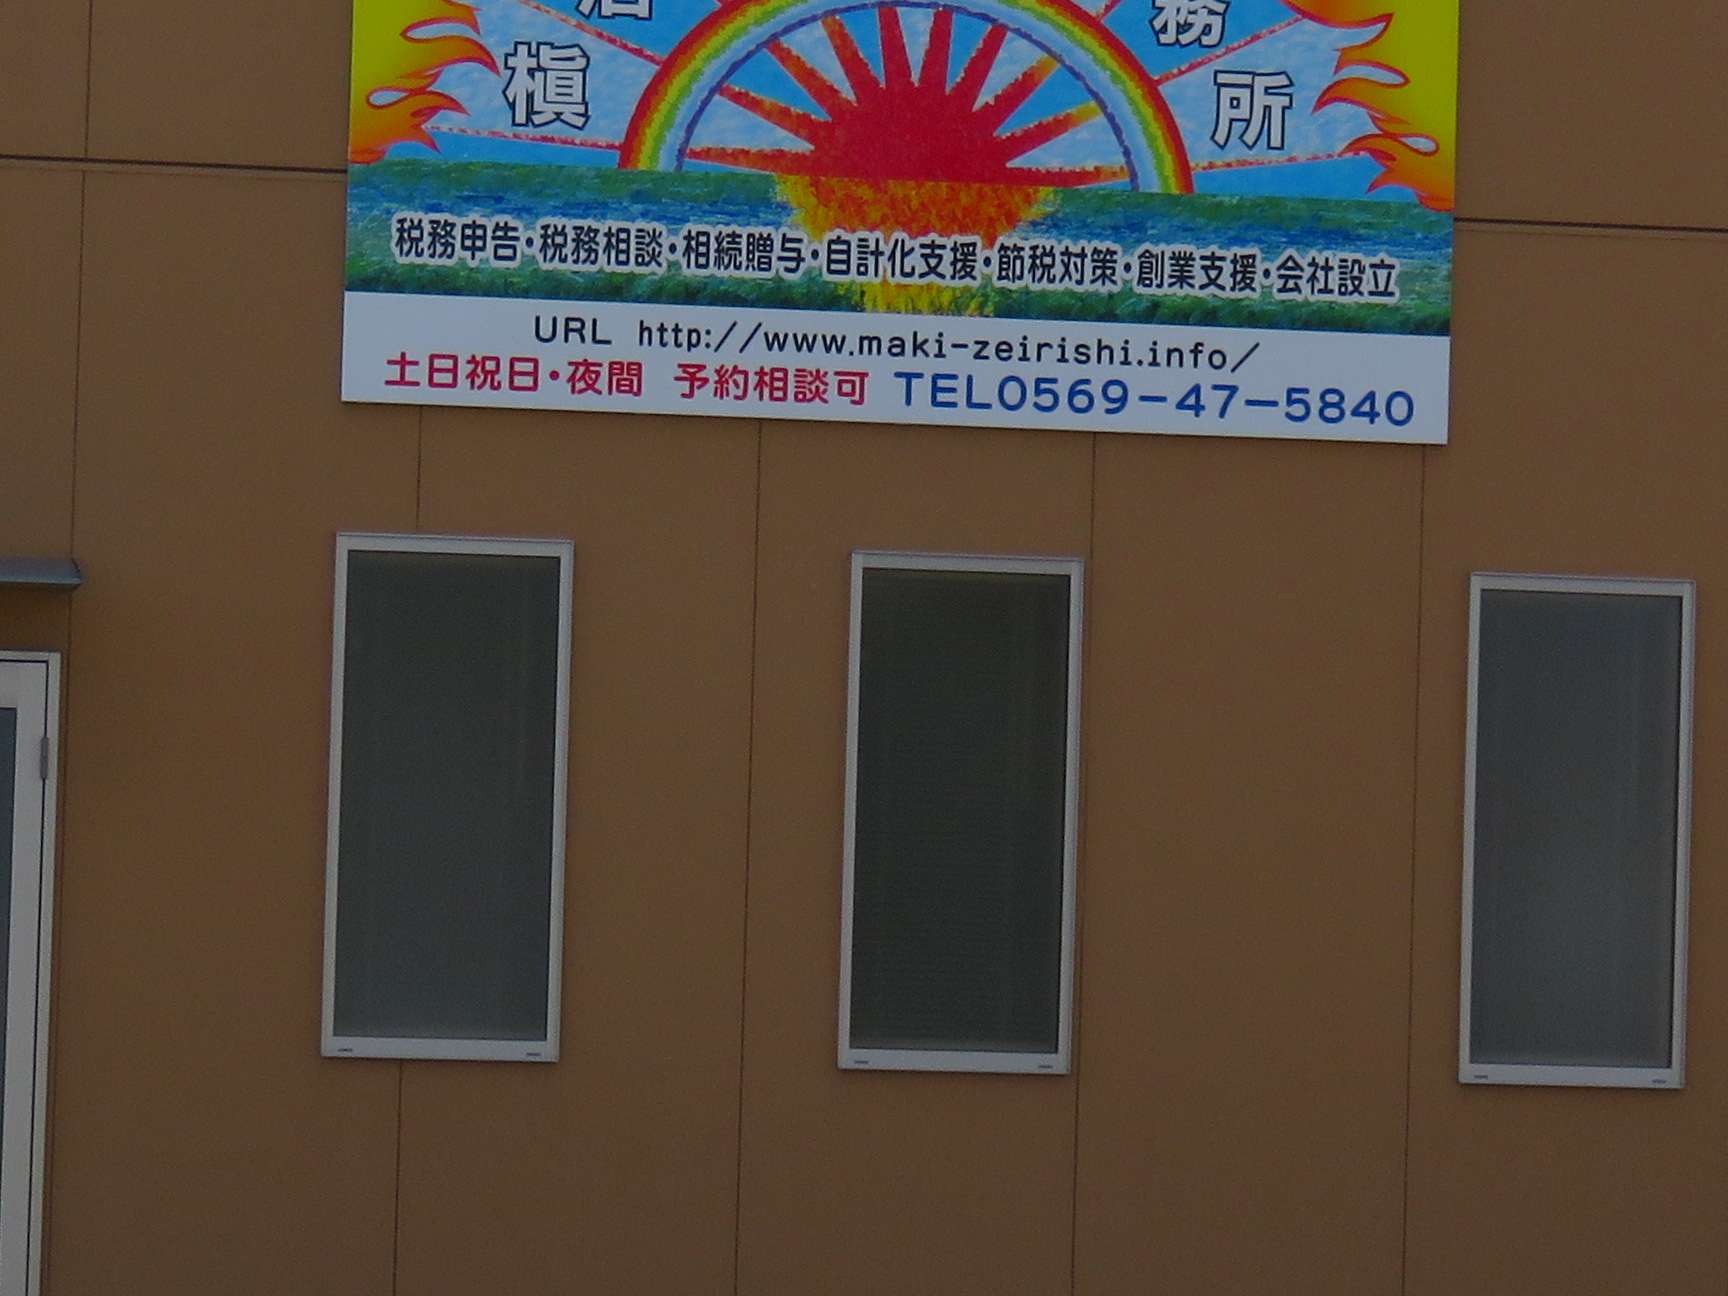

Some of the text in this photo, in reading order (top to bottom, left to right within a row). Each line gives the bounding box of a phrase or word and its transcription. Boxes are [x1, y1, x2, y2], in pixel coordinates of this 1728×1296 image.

[534, 315, 1260, 373] URL http://www.maki-zeirishi.info/
[383, 351, 1415, 427] 土日祝日・夜間 予約相談可 TEL0569-47-5840
